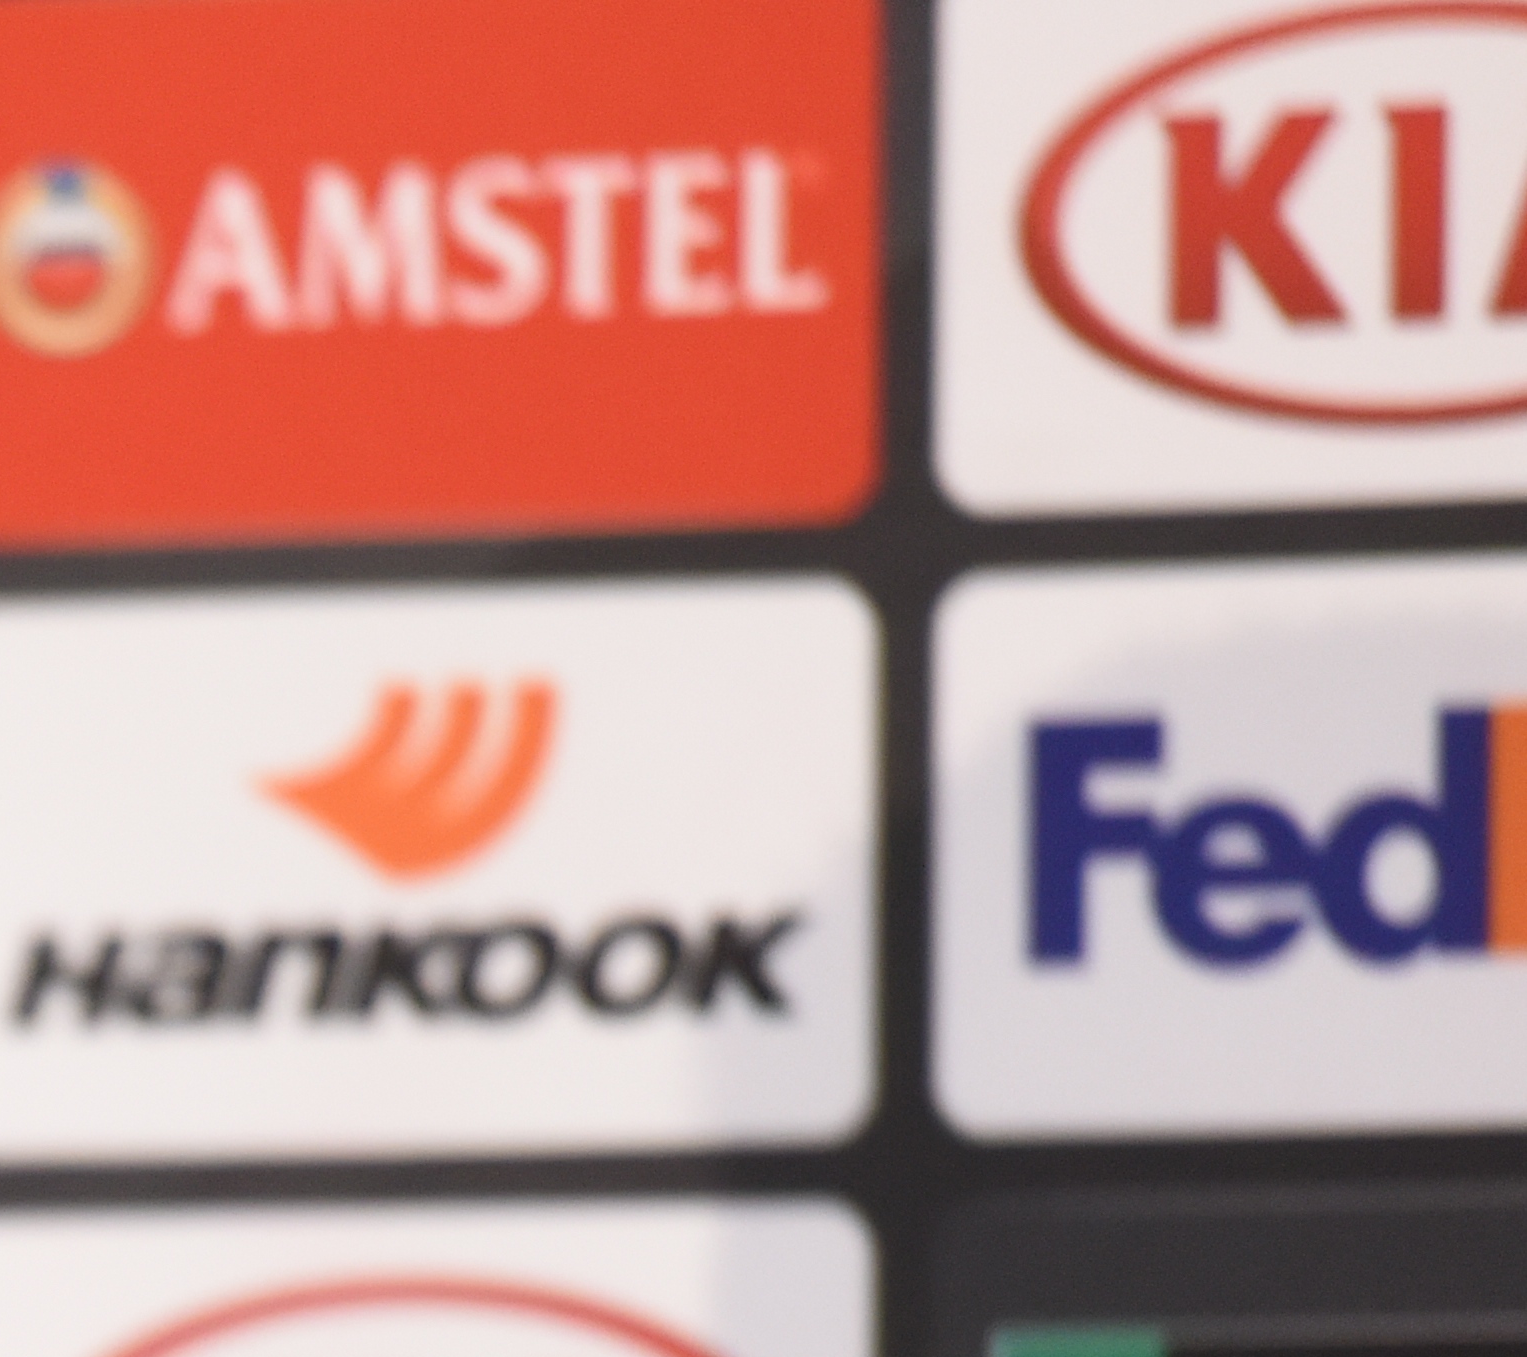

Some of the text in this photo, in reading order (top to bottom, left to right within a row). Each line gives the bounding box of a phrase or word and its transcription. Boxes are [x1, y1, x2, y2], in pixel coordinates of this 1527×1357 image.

[167, 148, 827, 334] AMSTEL
[1161, 102, 1527, 332] KI
[1023, 698, 1527, 974] Fed
